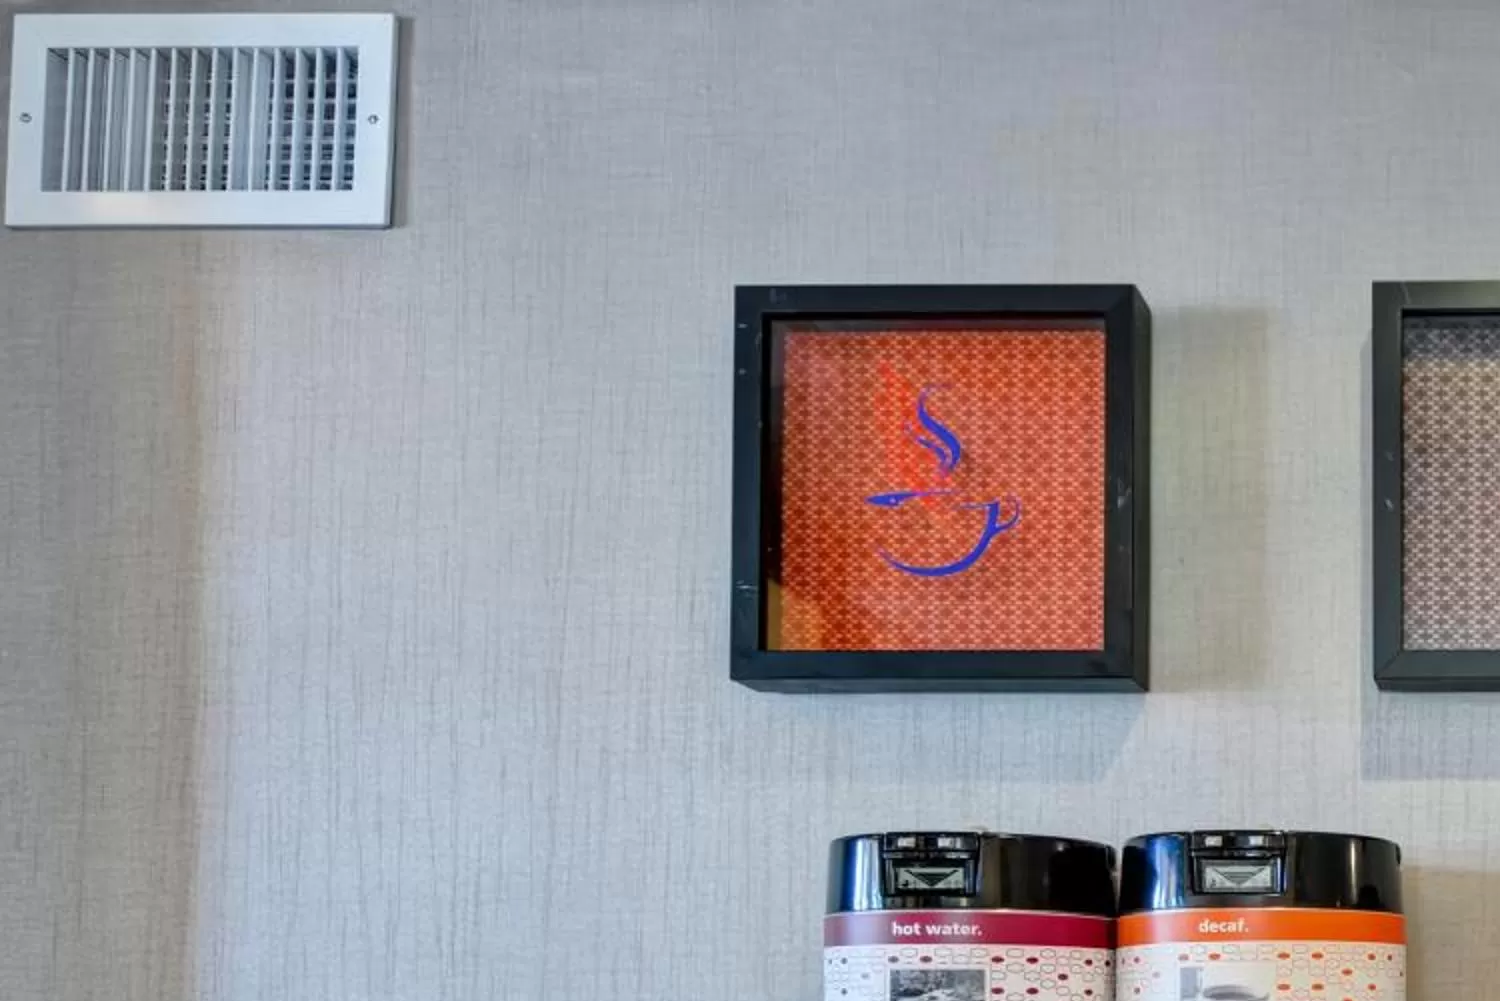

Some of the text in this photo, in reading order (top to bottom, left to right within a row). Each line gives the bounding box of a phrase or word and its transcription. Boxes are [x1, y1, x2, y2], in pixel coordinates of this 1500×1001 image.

[891, 921, 983, 936] hot water.
[1198, 917, 1249, 933] decaf.
